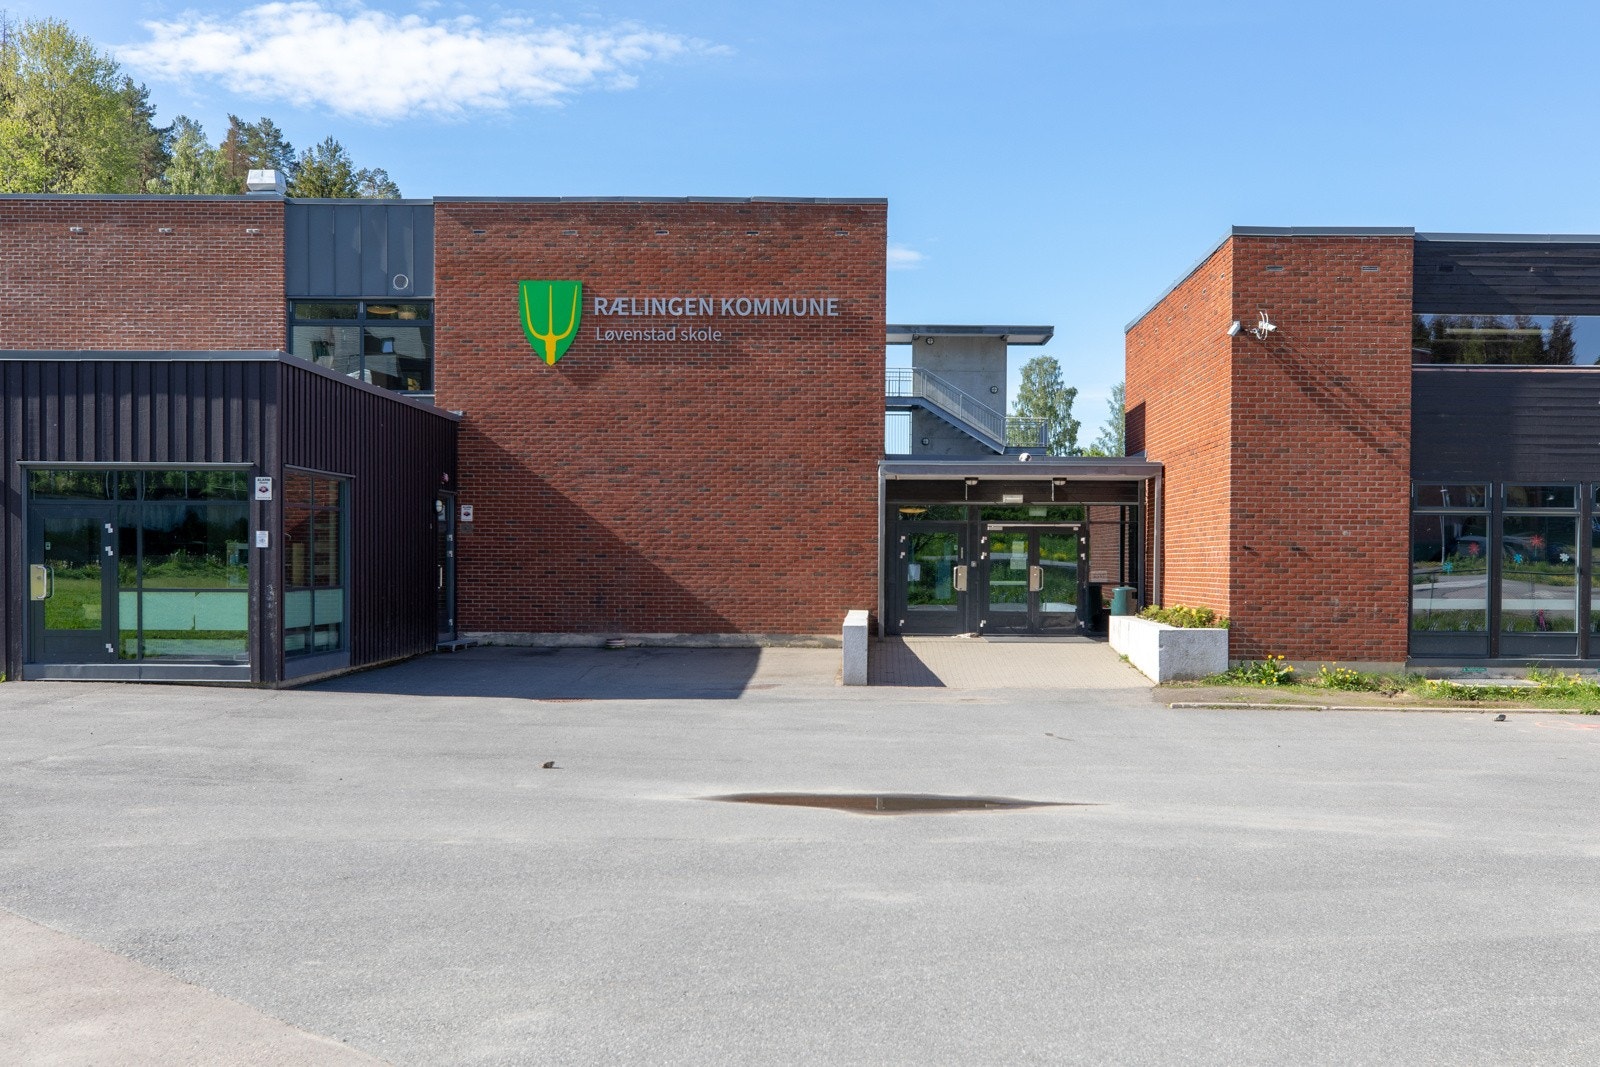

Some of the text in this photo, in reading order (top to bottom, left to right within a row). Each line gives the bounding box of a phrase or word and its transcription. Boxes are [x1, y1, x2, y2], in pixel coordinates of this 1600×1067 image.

[594, 297, 839, 317] RÆLINGEN KOMMUNE
[596, 326, 722, 342] Løvenstad skole
